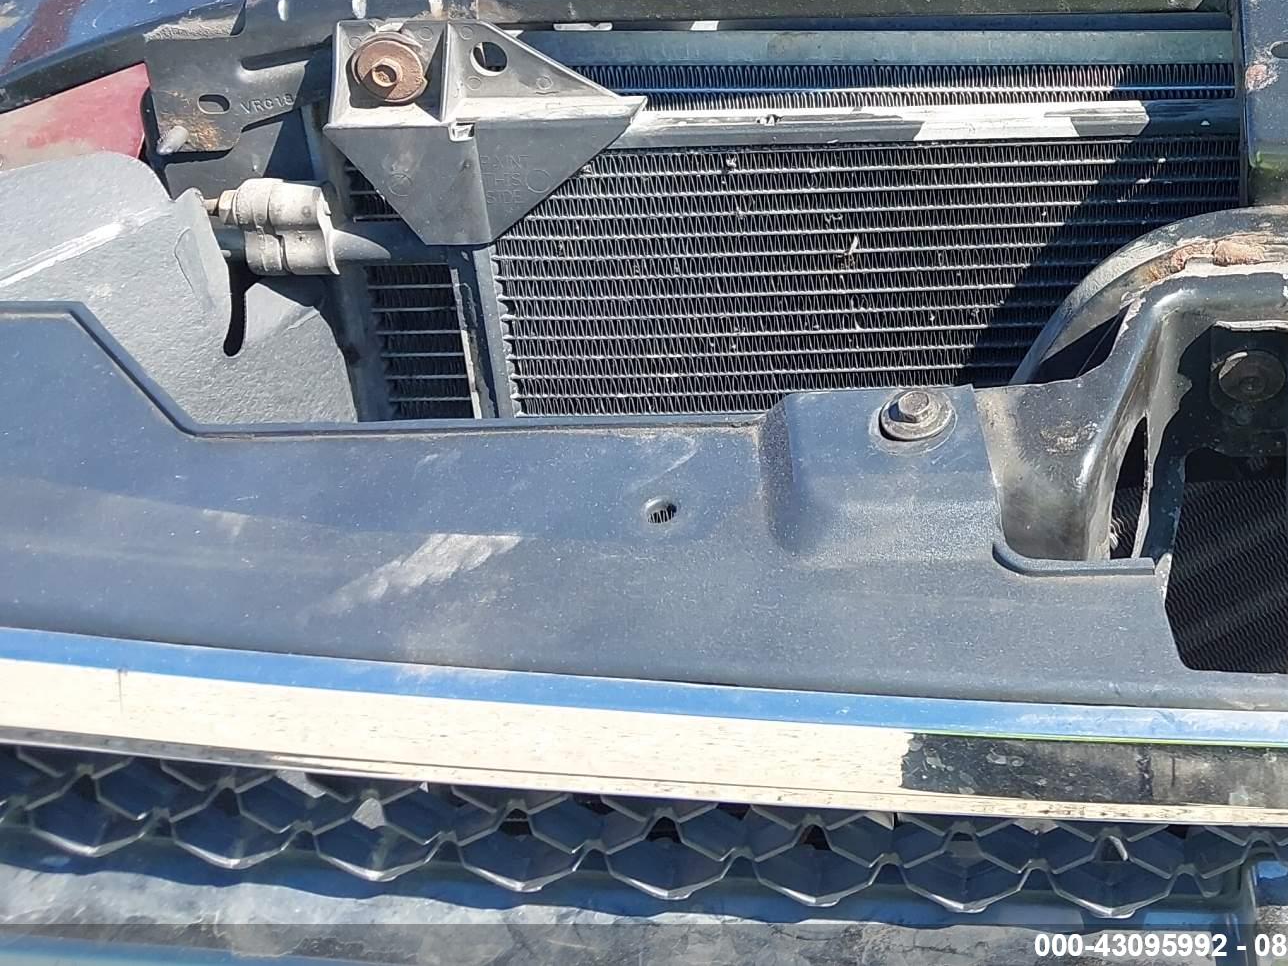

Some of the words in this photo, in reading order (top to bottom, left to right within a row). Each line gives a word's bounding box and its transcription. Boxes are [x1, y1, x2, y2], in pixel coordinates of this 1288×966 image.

[480, 154, 529, 170] PAINT
[483, 172, 522, 186] THIS
[486, 189, 525, 204] SIDE
